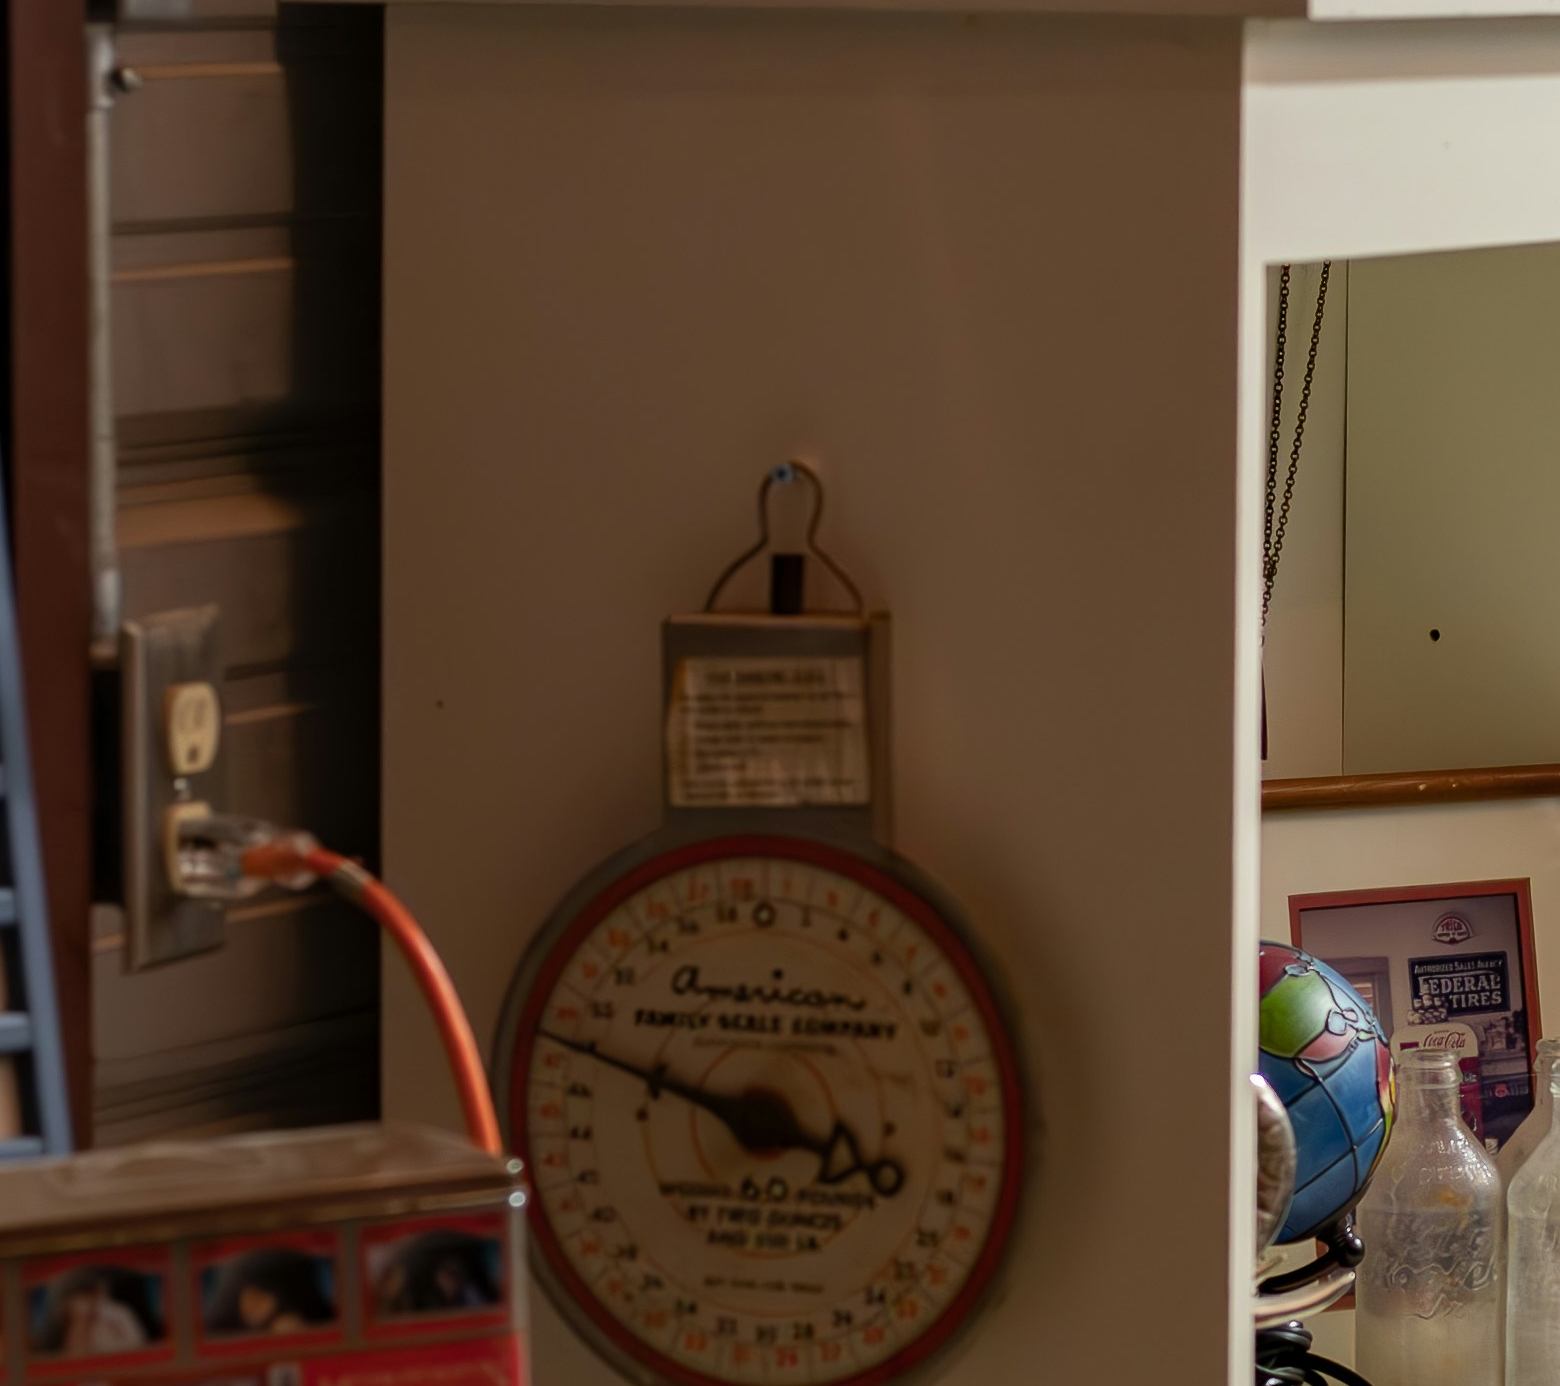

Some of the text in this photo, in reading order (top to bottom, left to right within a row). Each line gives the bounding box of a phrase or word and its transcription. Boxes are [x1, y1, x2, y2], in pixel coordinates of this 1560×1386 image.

[671, 965, 868, 1012] American
[1418, 973, 1501, 995] FEDERAL
[1449, 990, 1502, 1009] TIRES
[634, 1008, 898, 1040] FAMILY SCALE COMPANY
